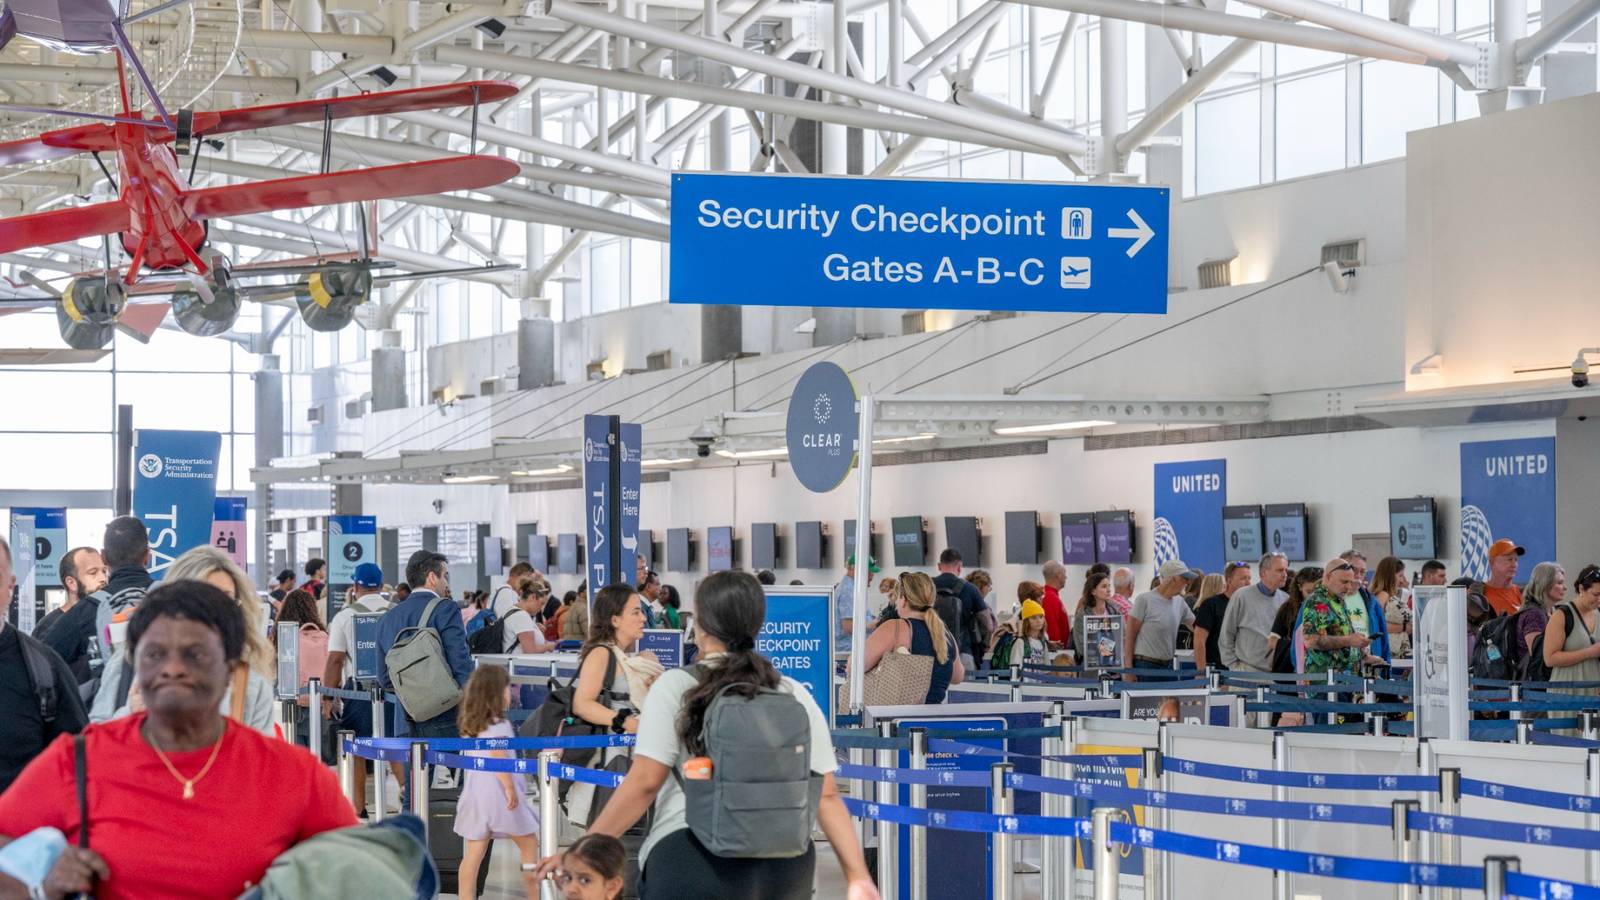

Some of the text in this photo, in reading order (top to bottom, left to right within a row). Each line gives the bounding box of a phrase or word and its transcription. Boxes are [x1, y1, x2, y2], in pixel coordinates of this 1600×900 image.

[698, 199, 1046, 241] Security Checkpoint
[823, 253, 1044, 286] Gates A-B-C
[802, 433, 840, 448] CLEAR
[164, 456, 213, 466] Transportation
[1486, 454, 1547, 477] UNITED
[164, 464, 193, 473] Security
[164, 470, 214, 479] Administration
[1172, 473, 1220, 493] UNITED
[622, 487, 639, 500] Enter
[622, 503, 638, 516] Here
[592, 482, 604, 553] TSA
[145, 504, 177, 574] TSA
[348, 545, 358, 557] 2
[759, 622, 811, 634] ECURITY
[356, 640, 377, 649] Enter
[755, 639, 821, 652] ECKPOINT
[771, 656, 811, 669] GATES
[1133, 708, 1146, 717] ARE
